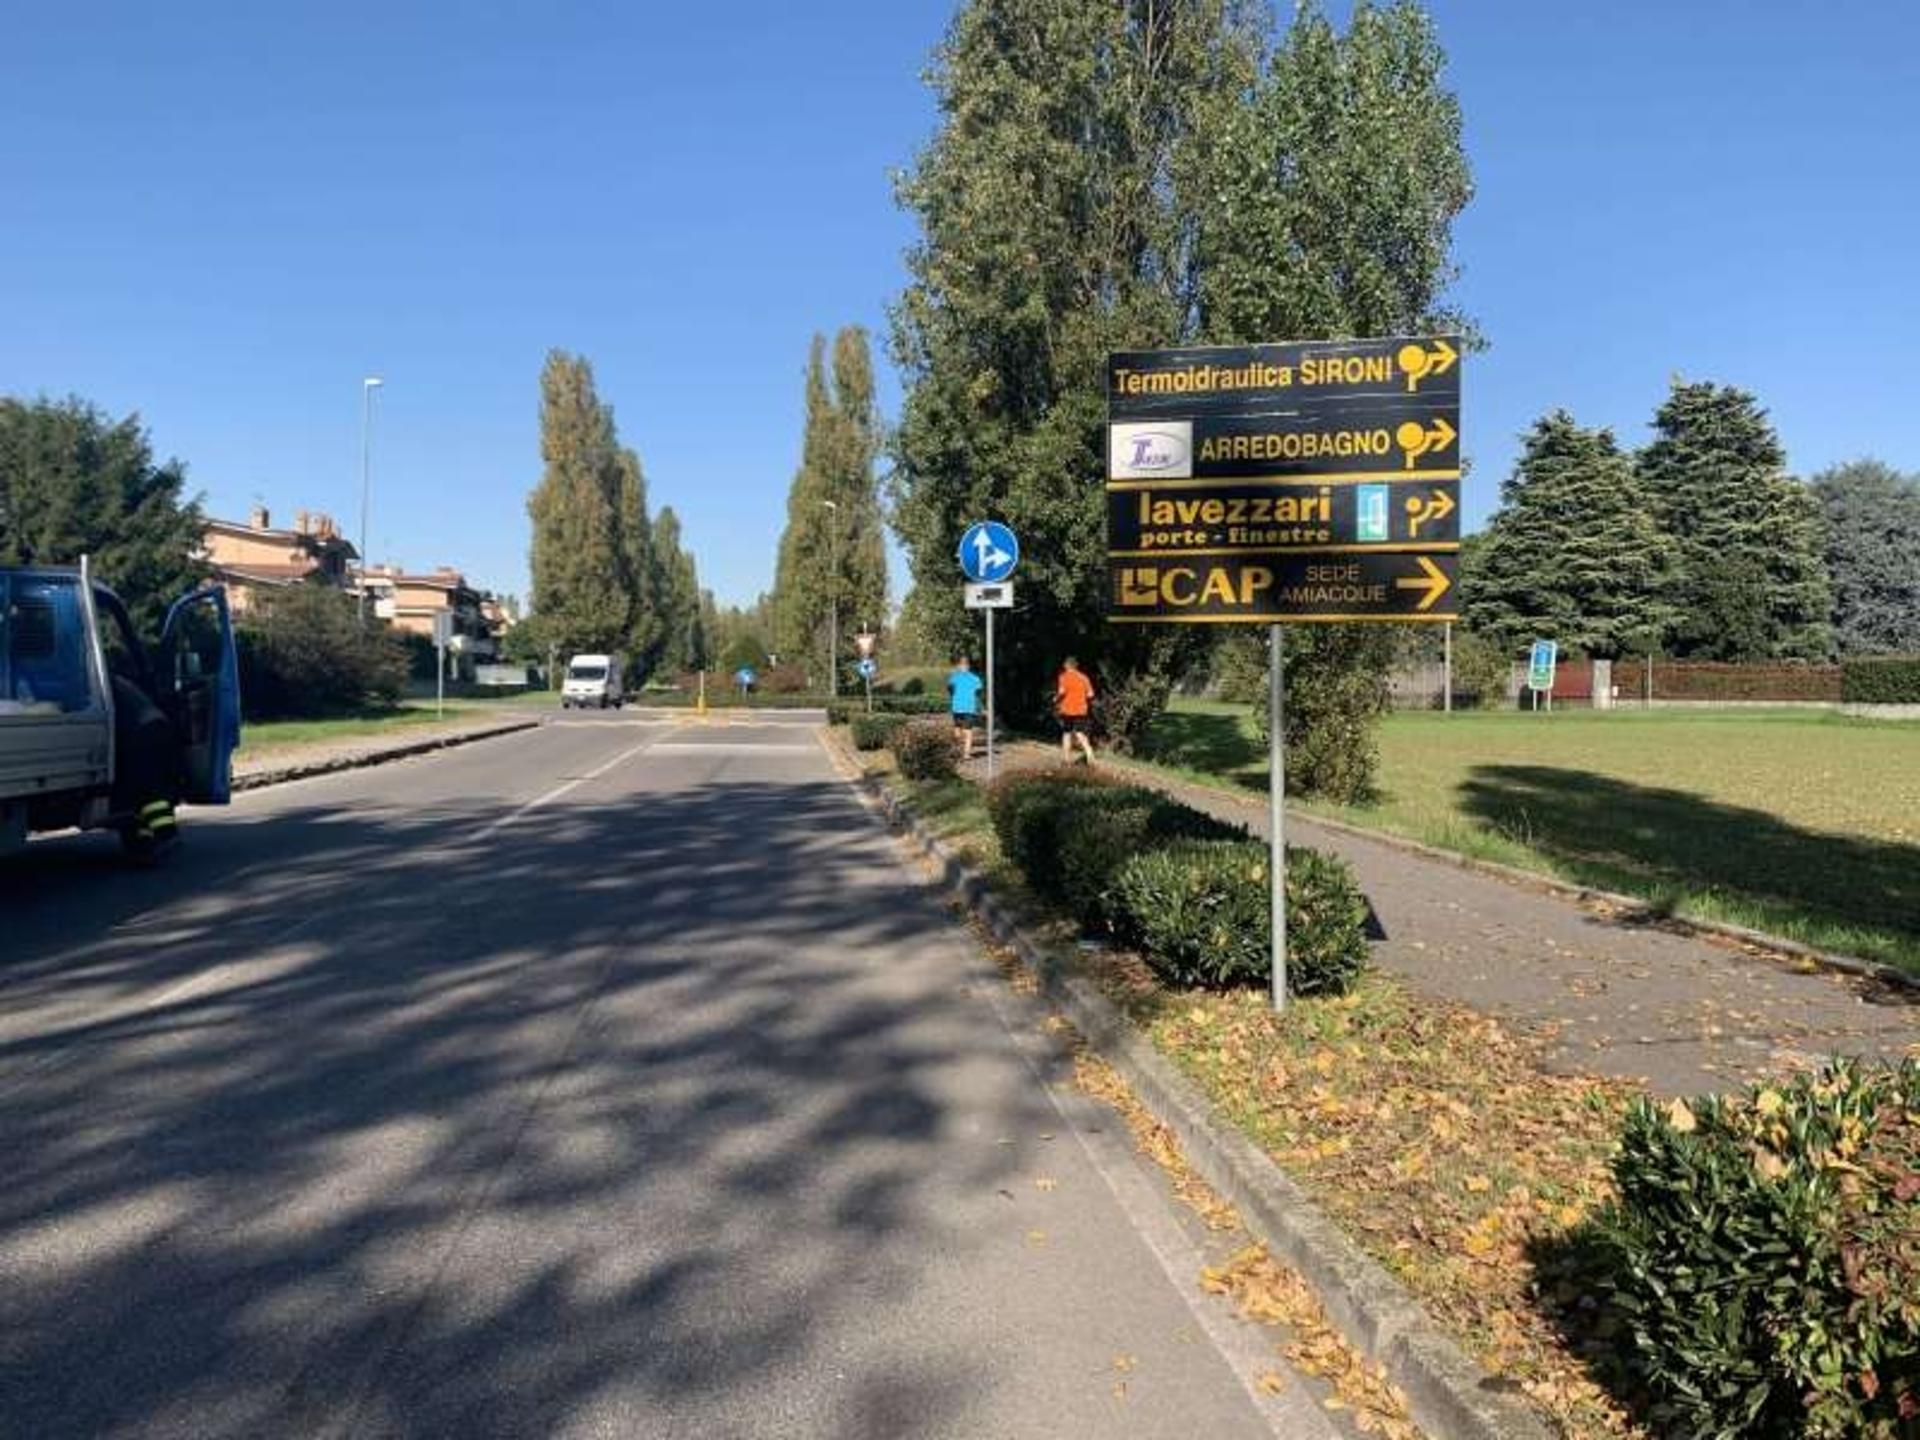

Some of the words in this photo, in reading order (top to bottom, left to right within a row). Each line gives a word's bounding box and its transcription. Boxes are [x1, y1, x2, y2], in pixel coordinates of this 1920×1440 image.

[1115, 362, 1292, 394] Termoidraulica
[1301, 356, 1392, 386] SIRONI
[1200, 429, 1390, 461] ARREDOBAGNO
[1140, 487, 1331, 525] lavezzari
[1140, 529, 1207, 548] porte
[1228, 525, 1330, 544] finestre
[1161, 565, 1273, 606] CAP
[1305, 564, 1361, 582] SEDE
[1280, 584, 1387, 604] AMIACQUE
